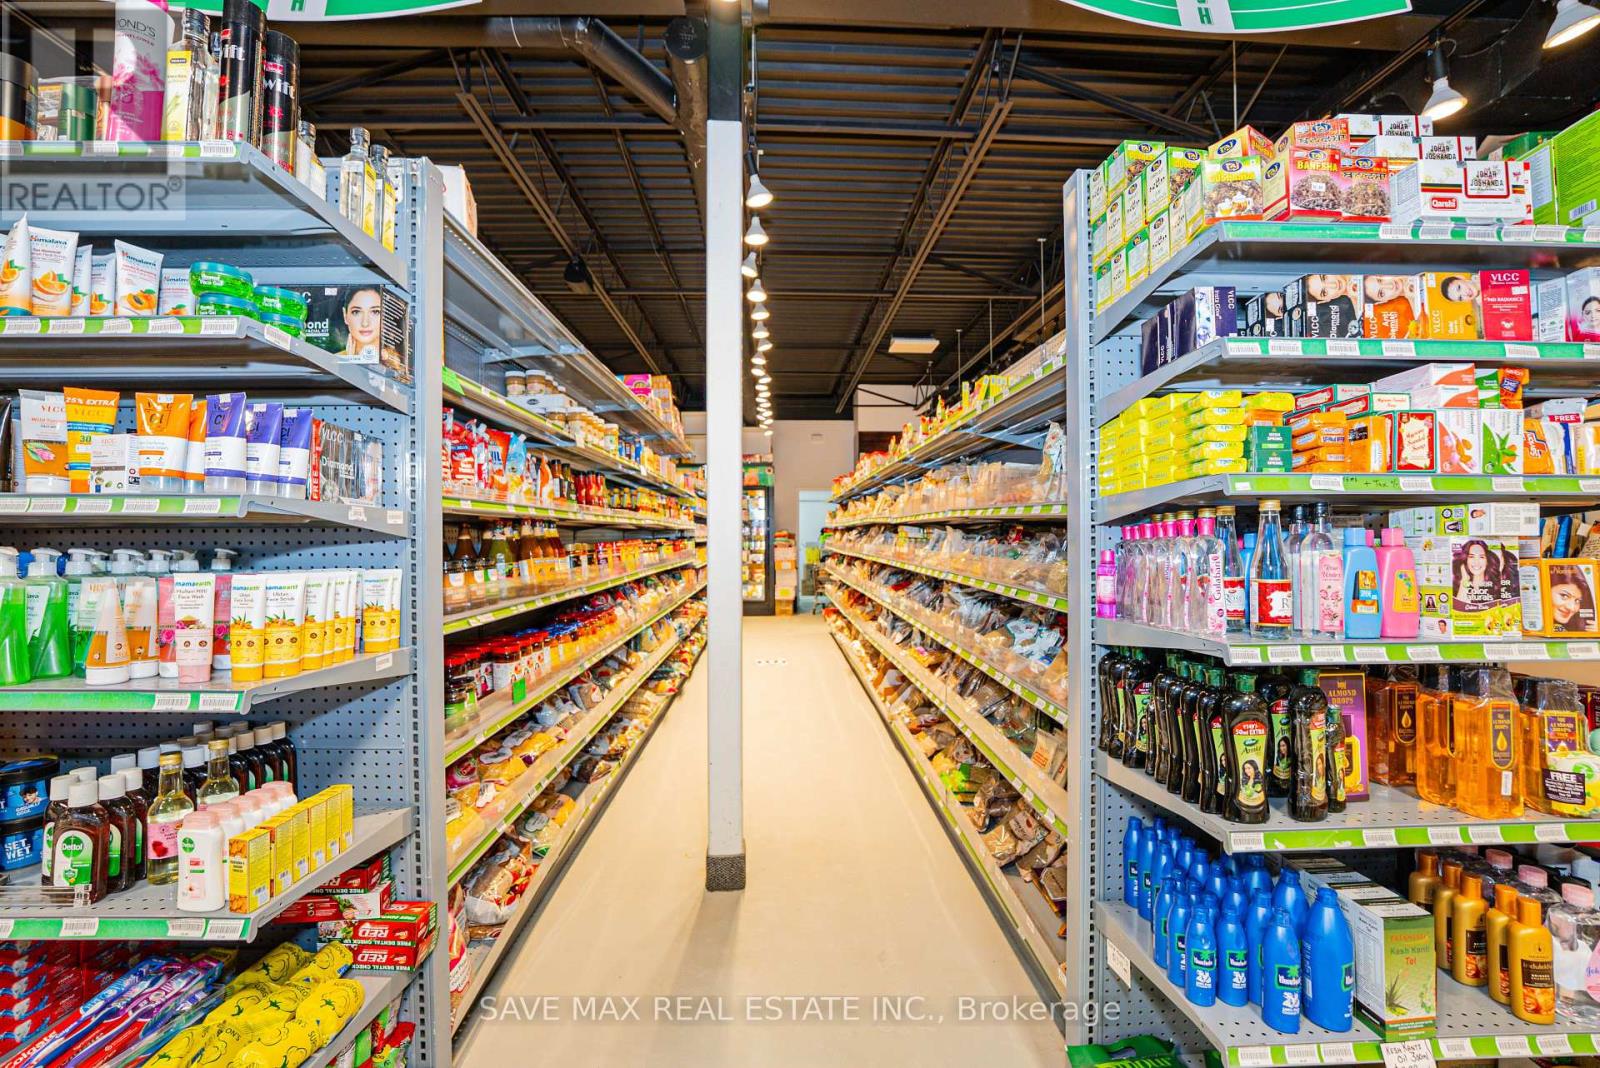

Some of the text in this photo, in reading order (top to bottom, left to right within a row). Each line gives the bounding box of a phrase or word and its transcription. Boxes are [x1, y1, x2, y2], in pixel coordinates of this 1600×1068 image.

[117, 18, 156, 38] OND'S
[1476, 170, 1497, 178] JOHAR
[1470, 179, 1504, 187] JOSHANDA
[1491, 273, 1520, 281] VLCC
[1330, 305, 1338, 338] Diamond
[1310, 316, 1319, 338] VLCC
[65, 397, 115, 407] 25% EXTRA
[1214, 559, 1222, 601] Gulabari
[1467, 587, 1488, 595] Color
[1328, 689, 1356, 697] ALMOND
[1332, 697, 1354, 705] DROPS
[1550, 771, 1577, 783] FREE
[4, 838, 27, 850] SET
[62, 843, 83, 851] Dettol
[6, 845, 32, 860] WET
[358, 929, 390, 938] RED
[1391, 947, 1409, 955] Kesh
[357, 953, 389, 963] RED
[1404, 957, 1416, 965] Tel
